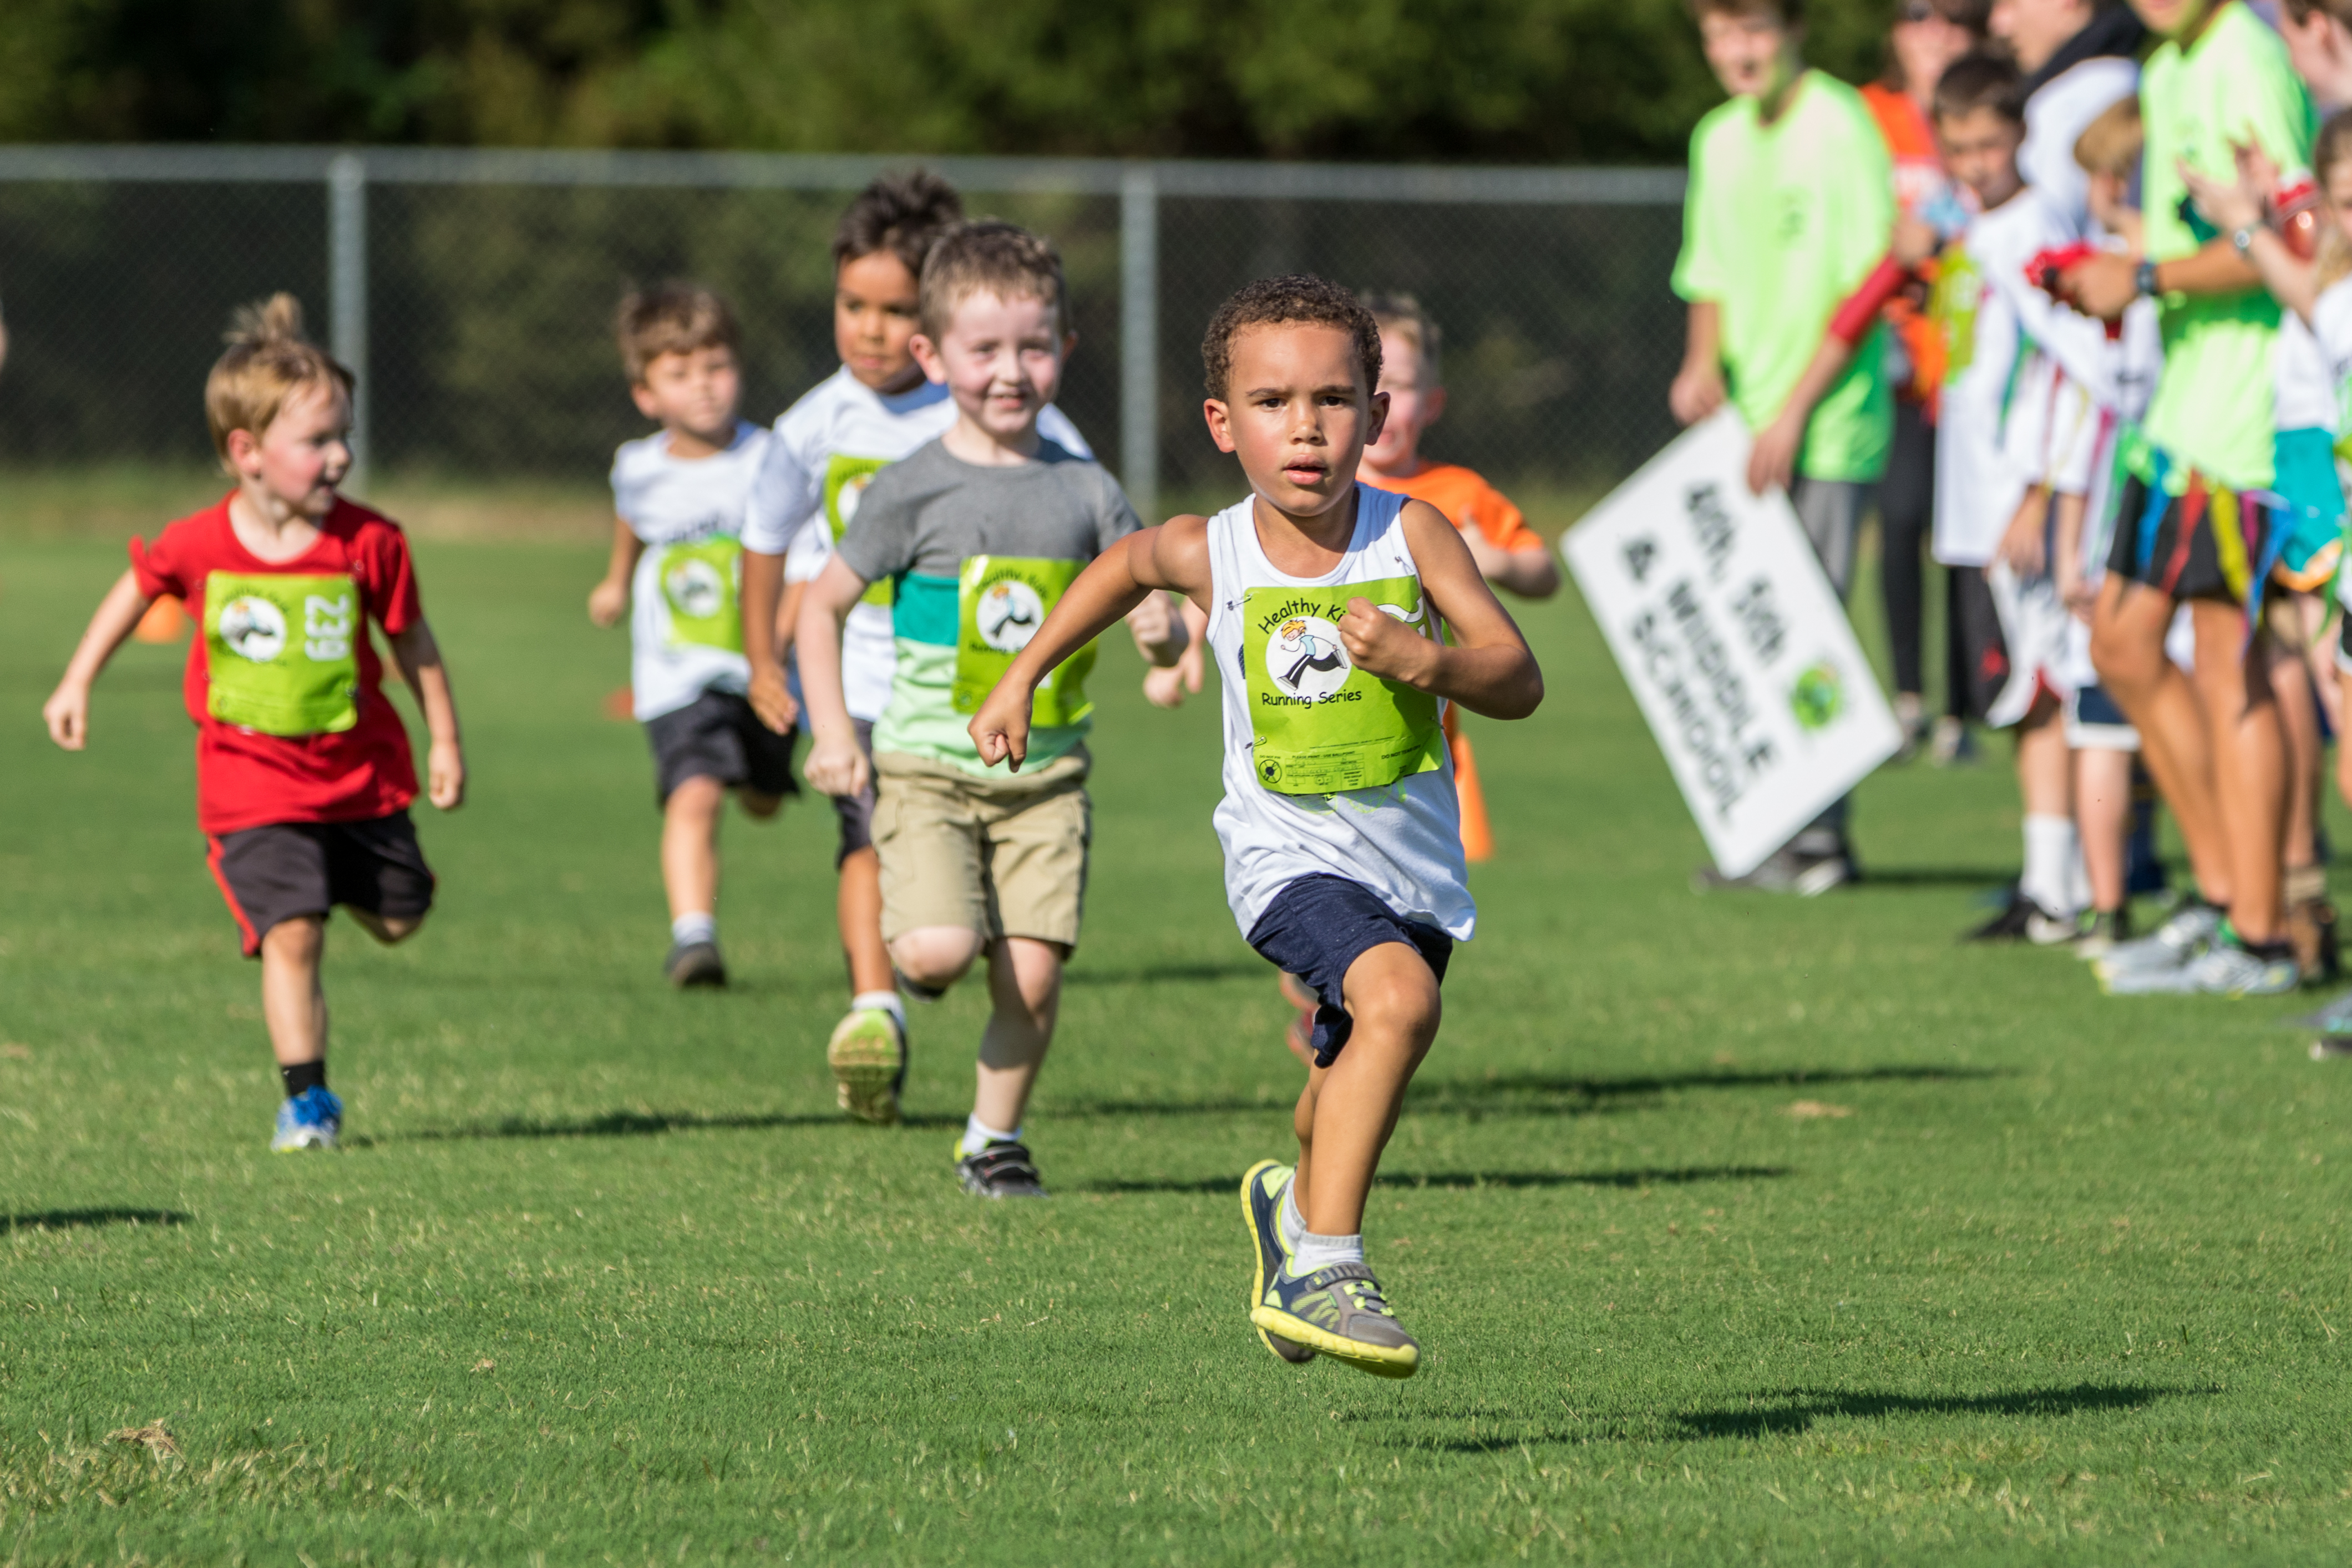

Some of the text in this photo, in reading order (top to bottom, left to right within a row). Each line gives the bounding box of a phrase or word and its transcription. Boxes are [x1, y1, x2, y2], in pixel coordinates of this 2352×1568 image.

[305, 594, 349, 661] 239
[1258, 597, 1321, 635] Healthy
[1326, 604, 1346, 622] Ki
[1261, 689, 1362, 709] Running Series
[1666, 576, 1775, 773] MIDDLE
[1630, 611, 1742, 822] SCHOOL
